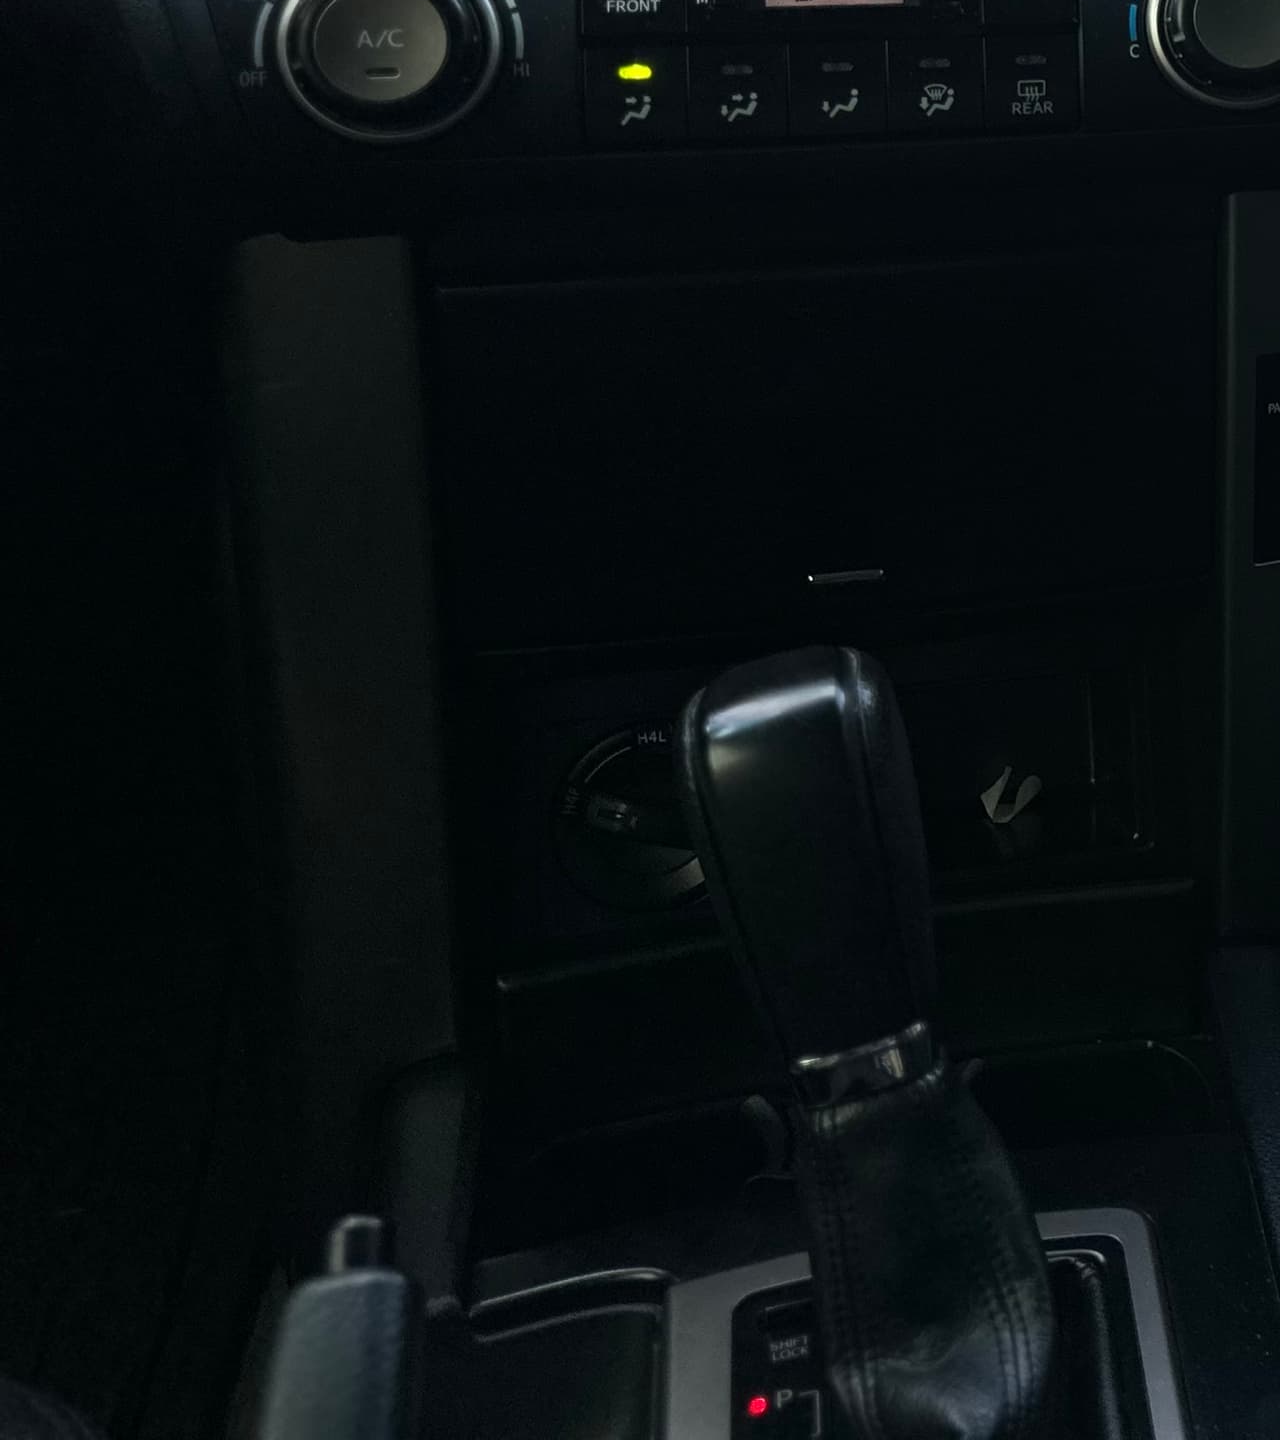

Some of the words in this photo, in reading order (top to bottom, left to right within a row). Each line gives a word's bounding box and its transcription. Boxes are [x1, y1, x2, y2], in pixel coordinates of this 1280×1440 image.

[606, 0, 661, 13] FRONT
[357, 29, 405, 49] A/C
[1129, 43, 1140, 59] C
[513, 63, 531, 77] HI
[239, 71, 267, 88] OFF
[1011, 100, 1053, 116] REAR
[637, 729, 667, 745] H4L
[770, 1335, 809, 1352] SHIFT
[772, 1346, 809, 1362] LOCK
[776, 1389, 793, 1409] P
